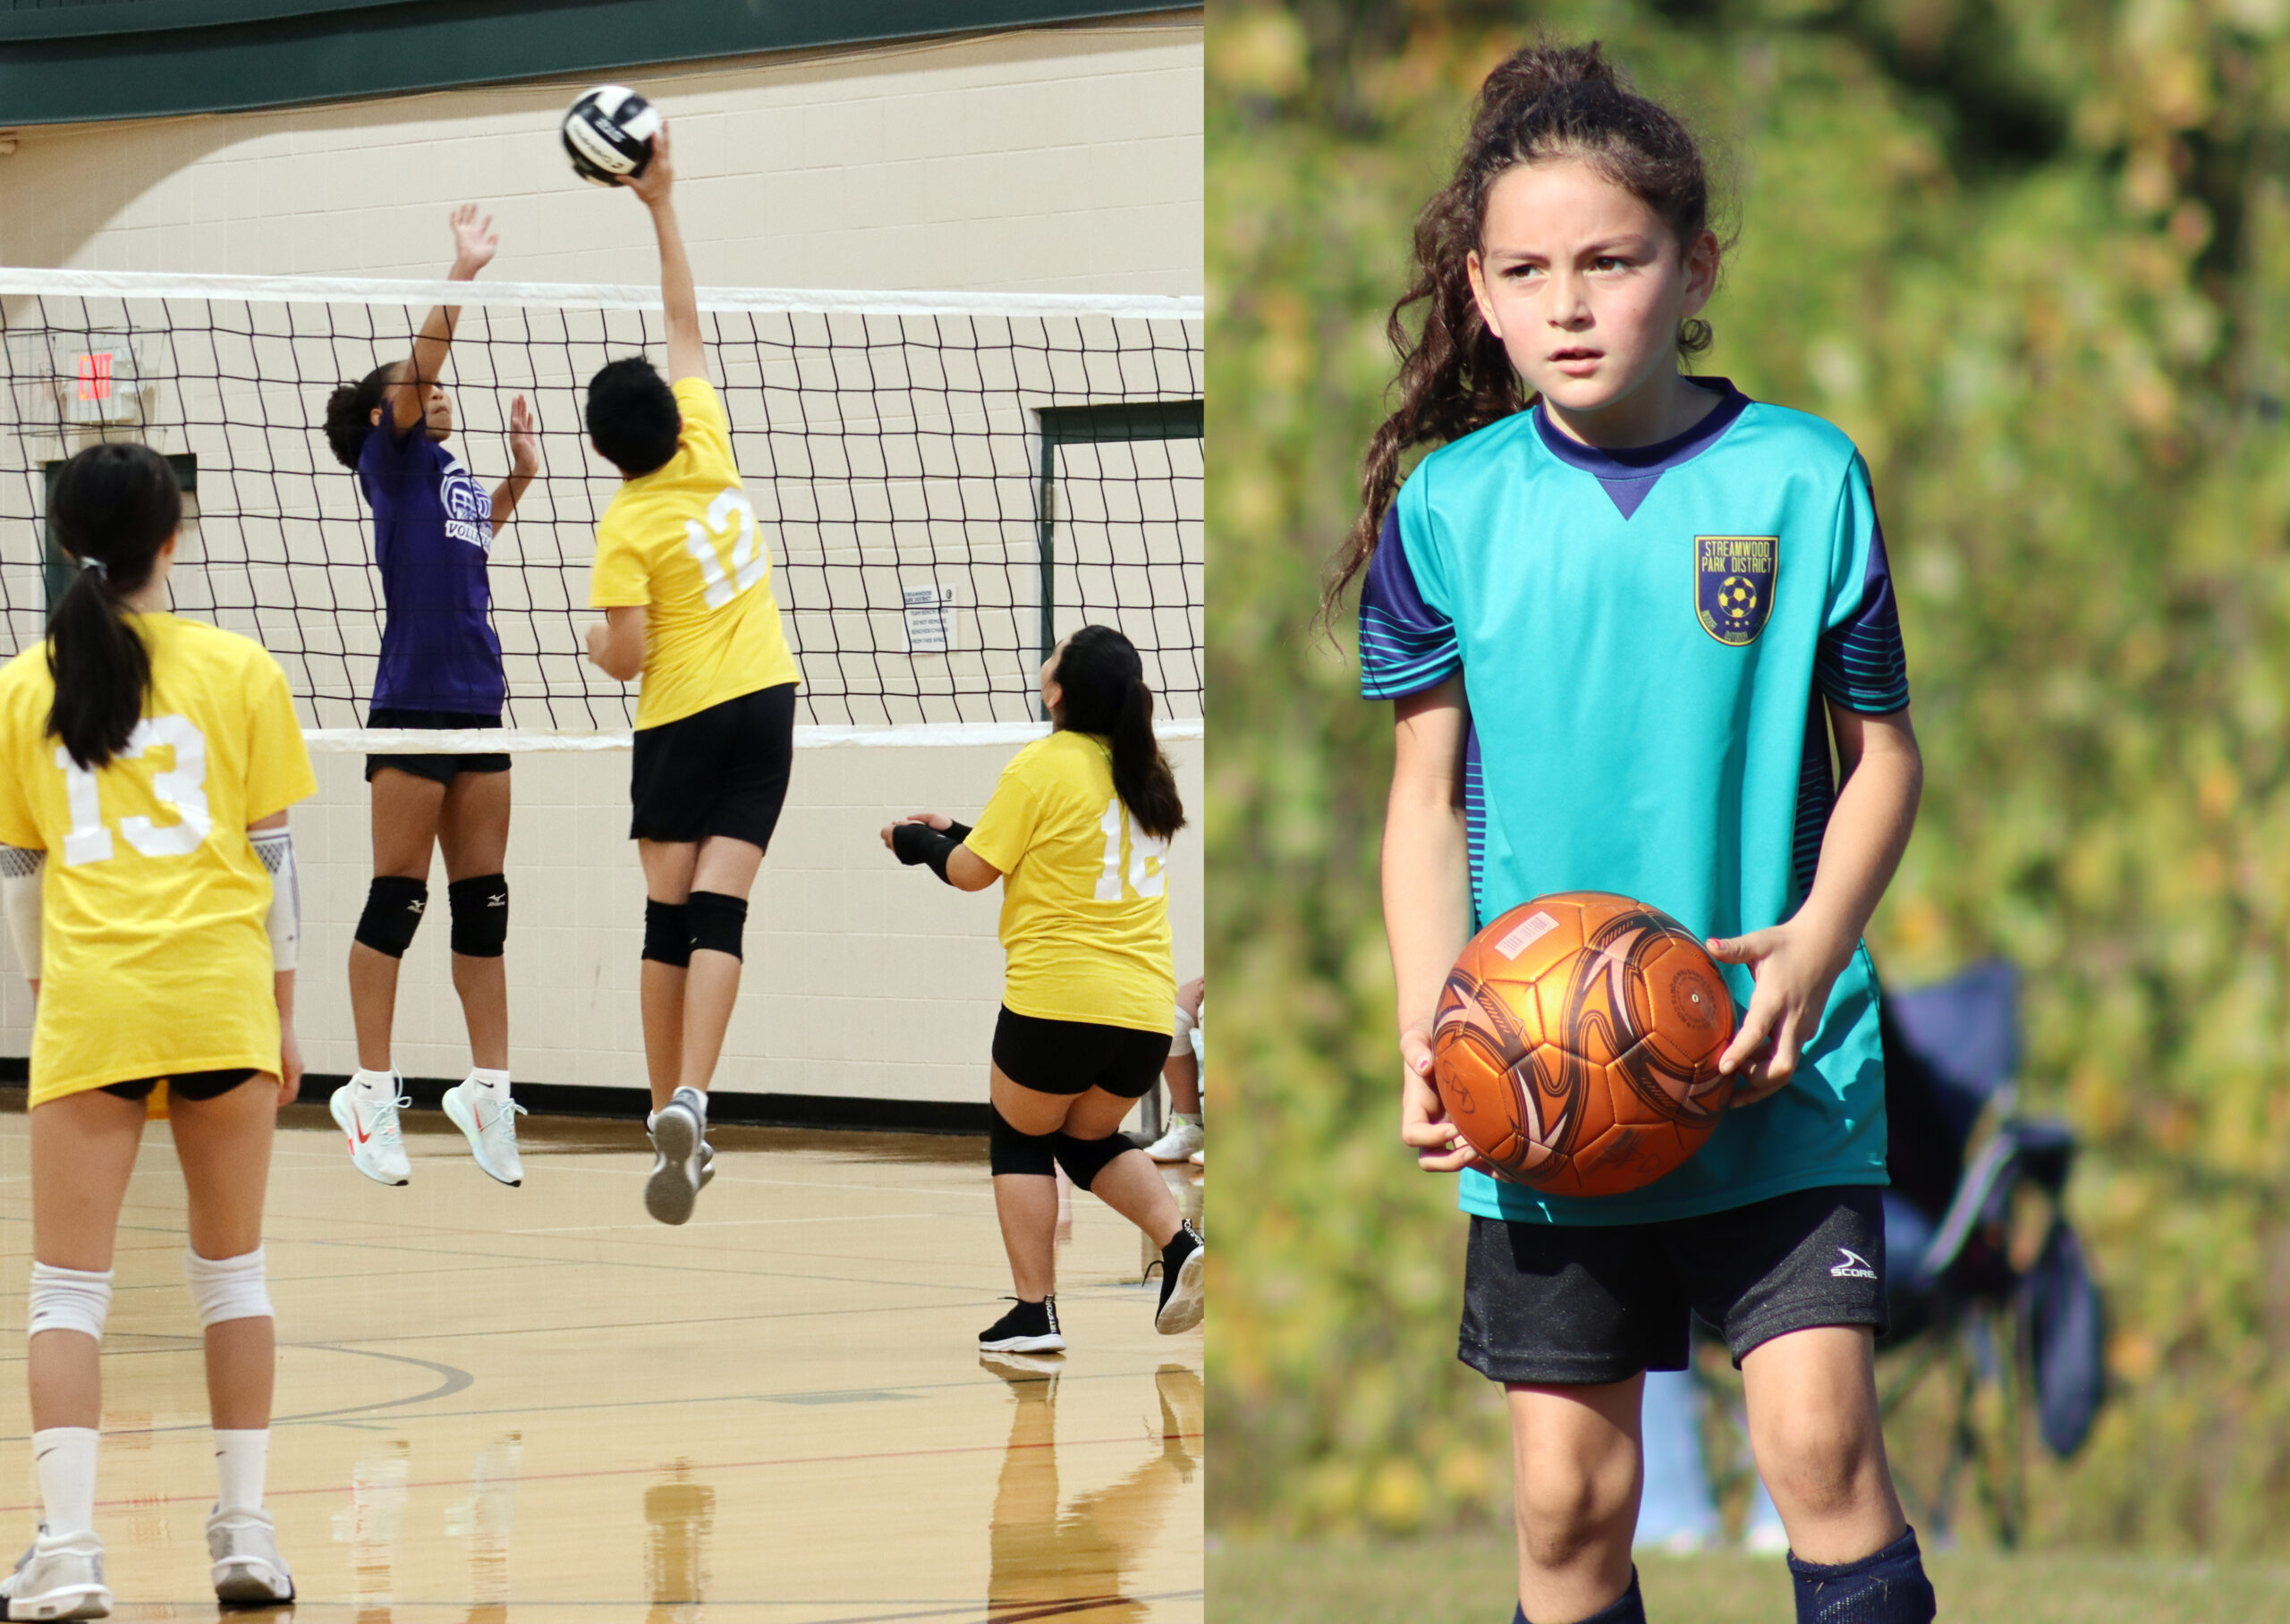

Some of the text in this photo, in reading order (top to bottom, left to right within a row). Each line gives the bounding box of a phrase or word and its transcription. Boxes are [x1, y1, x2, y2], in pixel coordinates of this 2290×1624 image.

[79, 353, 113, 401] EXIT
[685, 486, 768, 610] 12
[1705, 540, 1770, 557] STREAMWOOD
[1701, 556, 1772, 573] PARK DISTRICT
[55, 713, 212, 867] 13
[1830, 1268, 1876, 1279] SCORE
